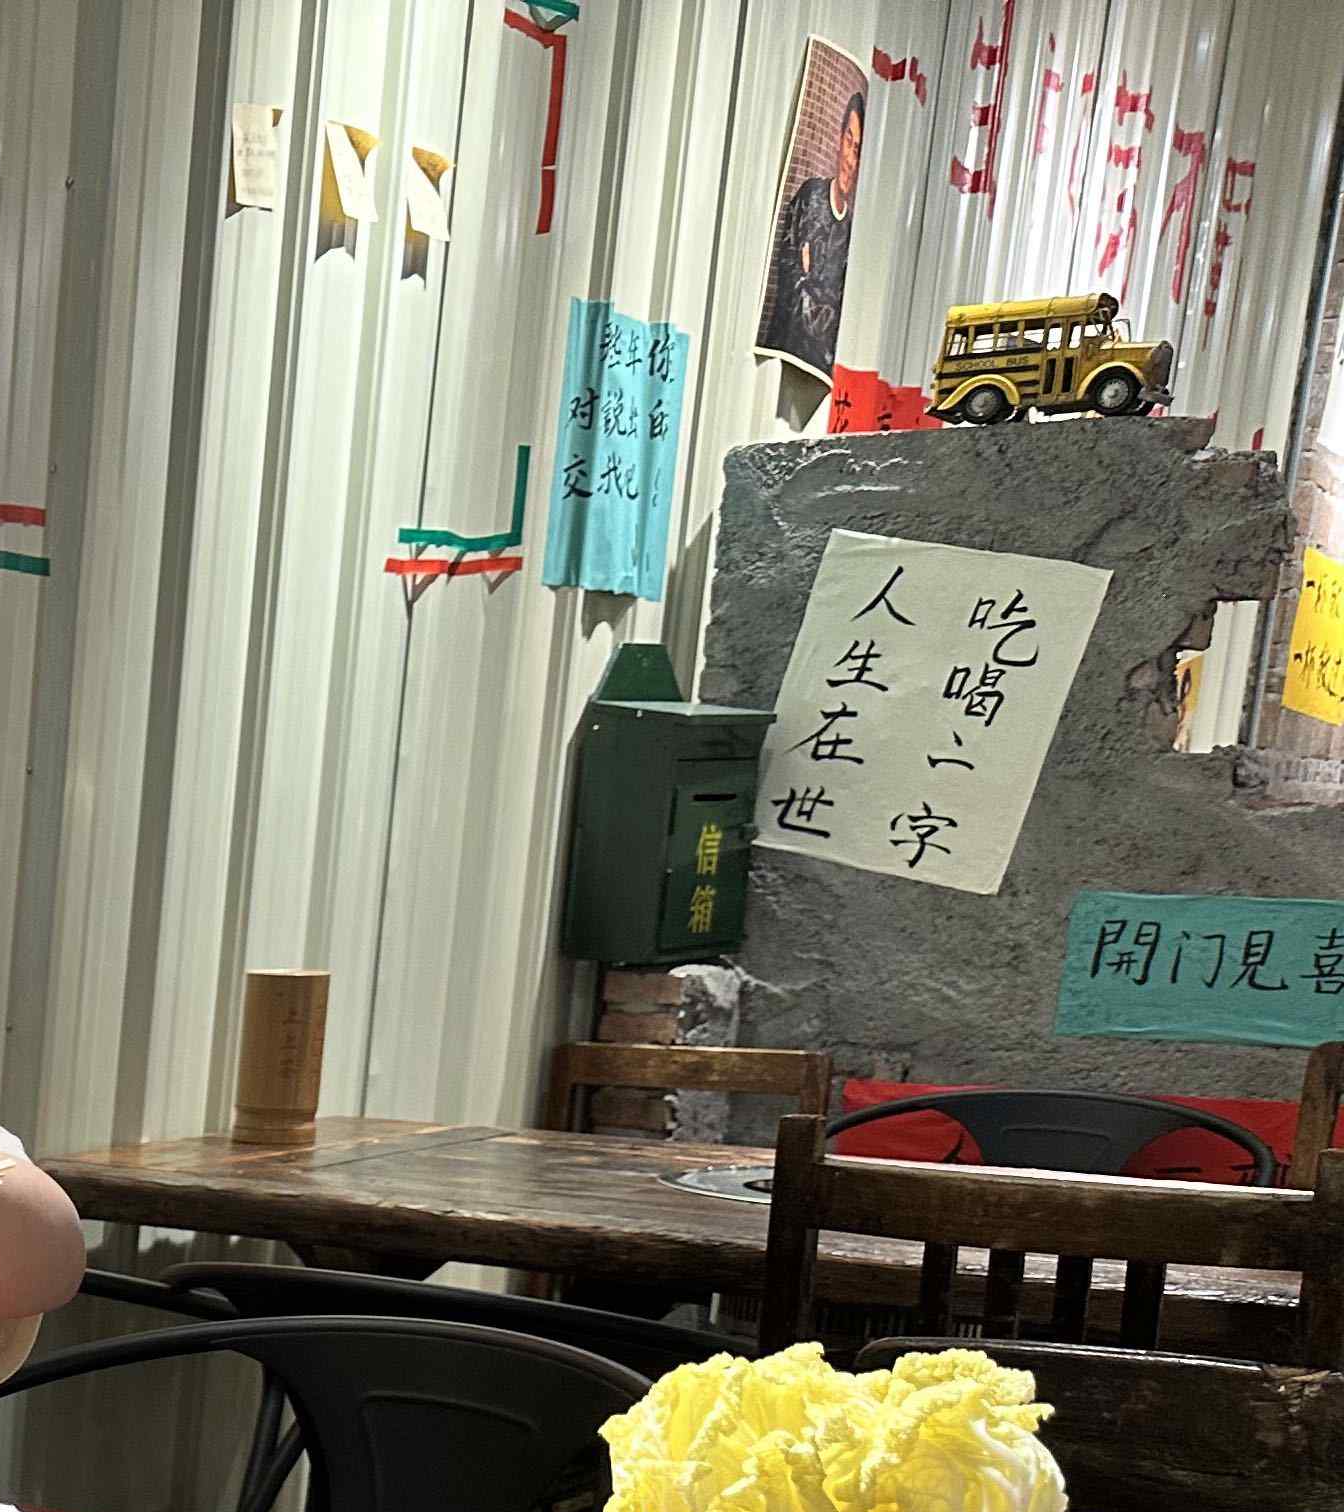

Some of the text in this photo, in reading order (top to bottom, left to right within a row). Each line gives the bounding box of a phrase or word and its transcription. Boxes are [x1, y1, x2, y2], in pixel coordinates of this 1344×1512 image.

[1006, 356, 1029, 366] BUS
[772, 565, 916, 841] 人生在世
[889, 588, 1039, 869] 吃喝二字
[688, 822, 723, 934] 信箱
